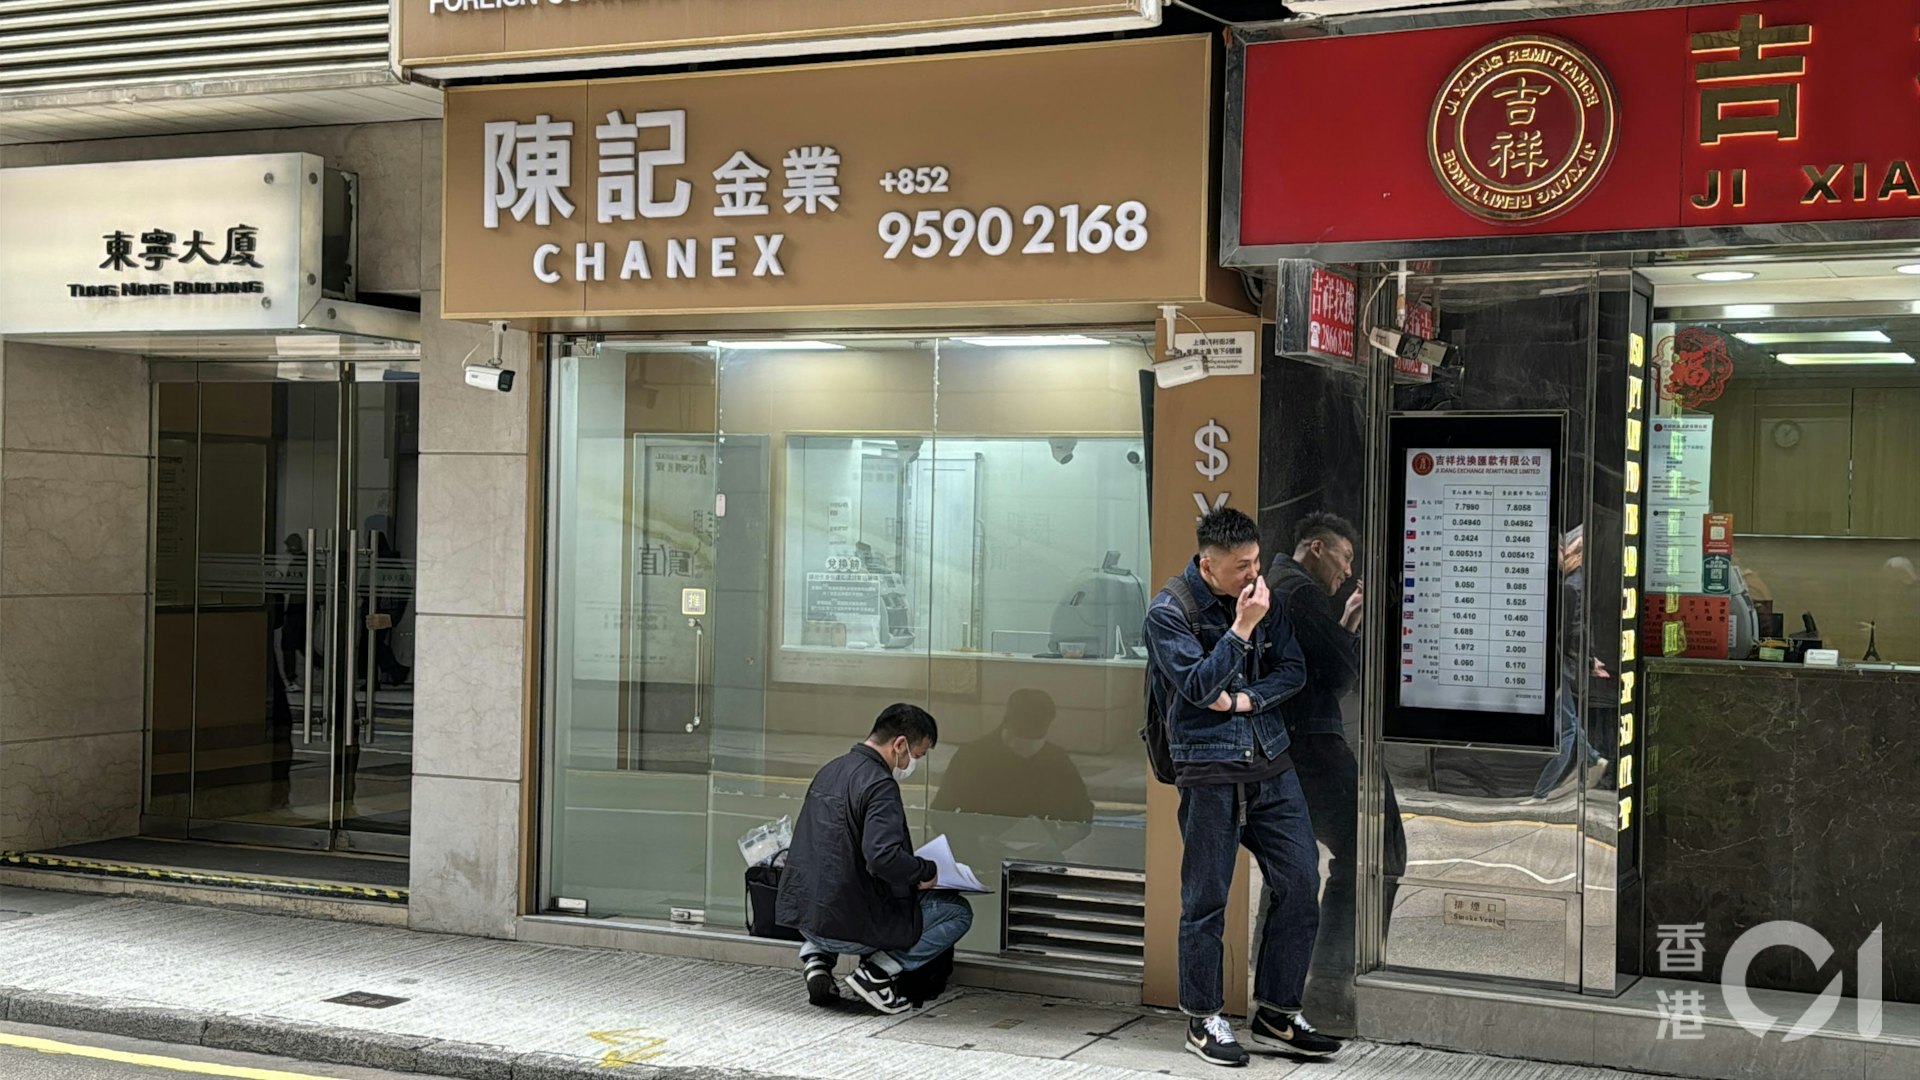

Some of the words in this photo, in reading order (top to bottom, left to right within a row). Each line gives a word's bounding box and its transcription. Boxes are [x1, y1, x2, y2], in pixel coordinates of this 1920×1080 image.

[1444, 99, 1461, 115] JI
[1453, 55, 1504, 98] XIANG
[1506, 47, 1600, 108] REMITTANCE
[1691, 14, 1812, 146] 吉
[1488, 76, 1552, 179] 吉祥
[1578, 142, 1597, 162] JI
[484, 109, 693, 228] 陳記
[712, 145, 842, 217] 金業
[879, 166, 949, 194] +852
[1536, 160, 1587, 205] XIANG
[1690, 168, 1747, 209] JI
[99, 223, 265, 271] 東寧大廈
[878, 207, 1013, 259] 9590
[1021, 200, 1148, 254] 2168
[532, 234, 785, 283] CHANEX
[1193, 418, 1230, 482] $
